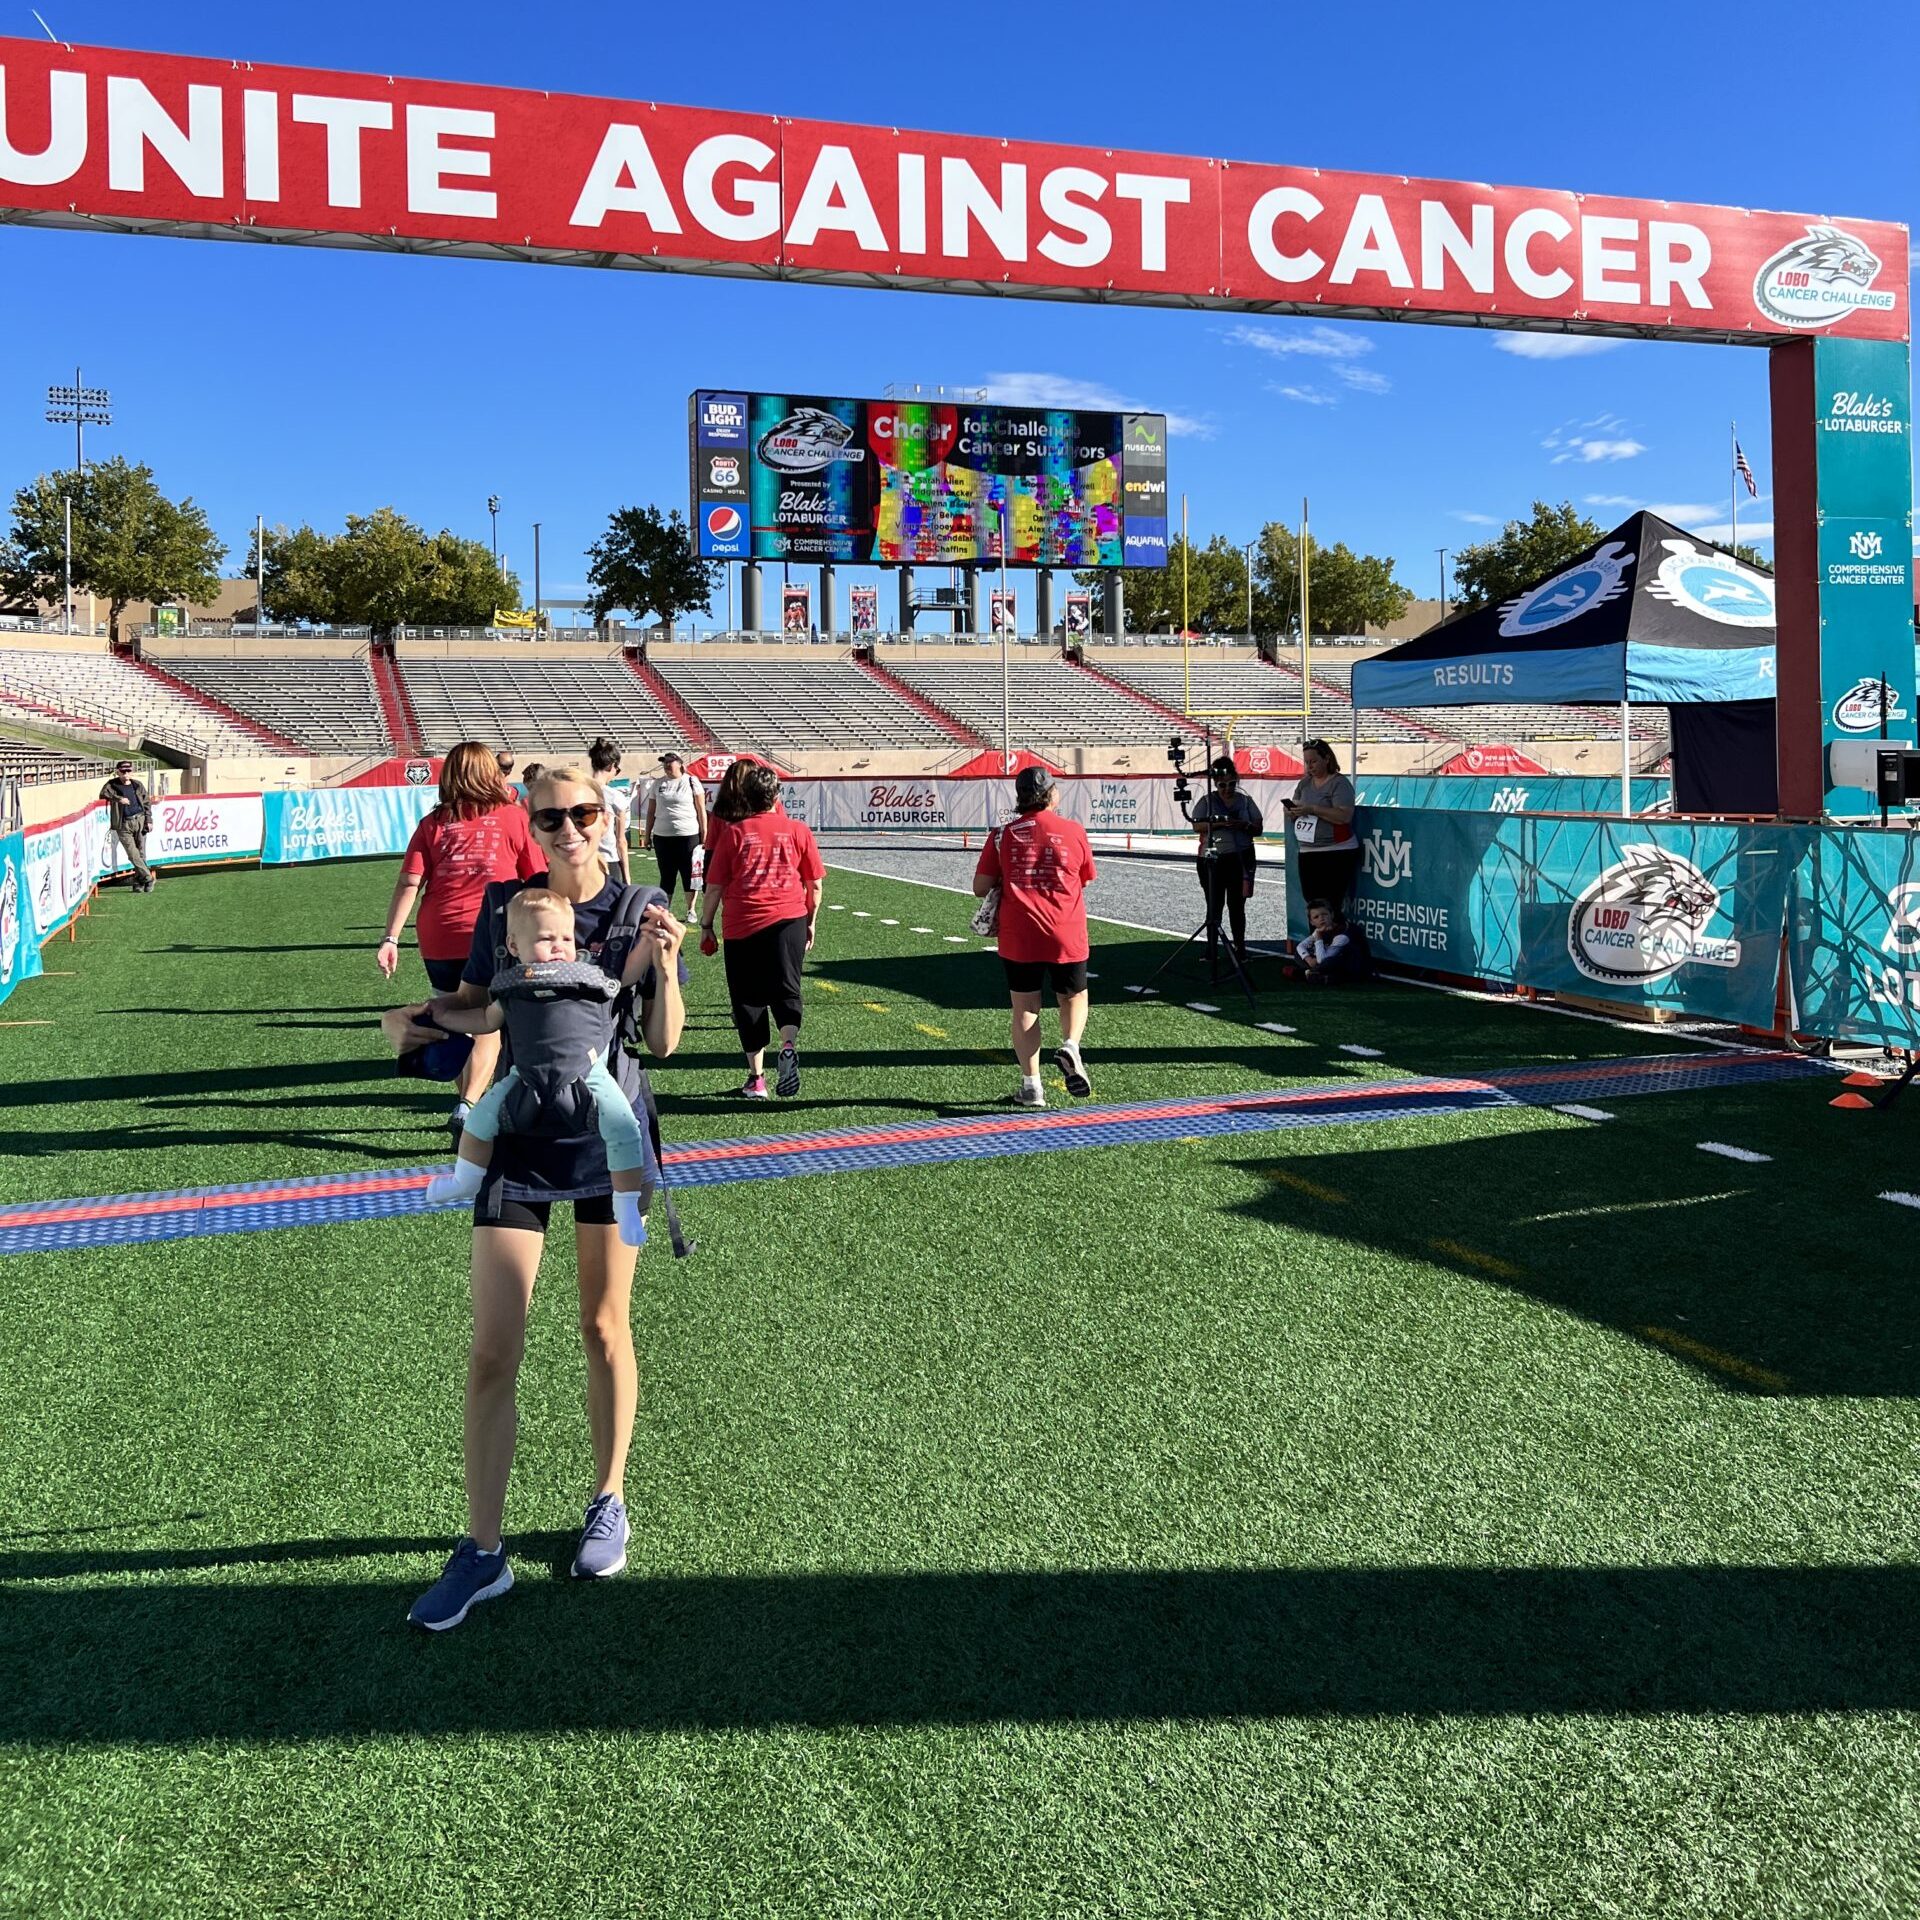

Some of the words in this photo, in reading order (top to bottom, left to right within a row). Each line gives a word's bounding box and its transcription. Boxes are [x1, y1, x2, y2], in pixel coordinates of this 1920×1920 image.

[0, 65, 497, 219] UNITE
[569, 123, 1191, 272] AGAINST
[1247, 186, 1714, 310] CANCER
[1777, 271, 1810, 288] LOBO
[1768, 286, 1819, 301] CANCER
[1821, 290, 1893, 307] CHALLENGE
[708, 403, 737, 416] BUD
[1831, 391, 1893, 417] Blake's
[703, 414, 743, 427] LIGHT
[1824, 418, 1902, 434] LOTABURGER
[963, 417, 988, 433] for
[994, 419, 1081, 439] Challene
[773, 437, 798, 448] LOBO
[807, 449, 862, 460] CHALLENGE
[1026, 441, 1106, 459] Suvors
[715, 460, 735, 468] ROUTE
[715, 469, 735, 482] 66
[790, 480, 822, 488] Presented
[1125, 480, 1165, 493] endwi
[779, 491, 837, 511] Blake's
[772, 513, 848, 525] LOTABURGER
[1125, 535, 1166, 548] AQUAFINA
[1849, 531, 1883, 560] UNM
[711, 543, 739, 554] pepsi
[1828, 564, 1905, 576] COMPREHENSIVE
[1829, 574, 1868, 585] CANCER
[1868, 574, 1905, 585] CENTER
[1433, 663, 1514, 687] RESULTS
[1845, 703, 1862, 712] LOBO
[1840, 711, 1867, 719] CANCER
[1867, 711, 1905, 719] CHAENGE
[710, 758, 734, 767] 96.3
[1252, 758, 1267, 767] 66
[1101, 784, 1117, 794] I'M
[1120, 784, 1128, 794] A
[868, 785, 936, 808] Blake's
[783, 799, 806, 809] CER
[1091, 799, 1137, 809] CANCER
[162, 805, 220, 833] Blake's
[290, 805, 357, 831] Blake's
[861, 810, 946, 823] LOTABURGER
[1089, 813, 1137, 824] FIGHTER
[1296, 820, 1314, 831] 677
[282, 828, 371, 850] LOTABURGER
[1361, 829, 1413, 888] UNM
[1341, 897, 1449, 928] MPREHENSIVE
[1594, 907, 1631, 930] LOBO
[1389, 924, 1448, 951] CENTER
[1584, 928, 1636, 950] CANCER
[1640, 935, 1737, 963] CHALLENGE
